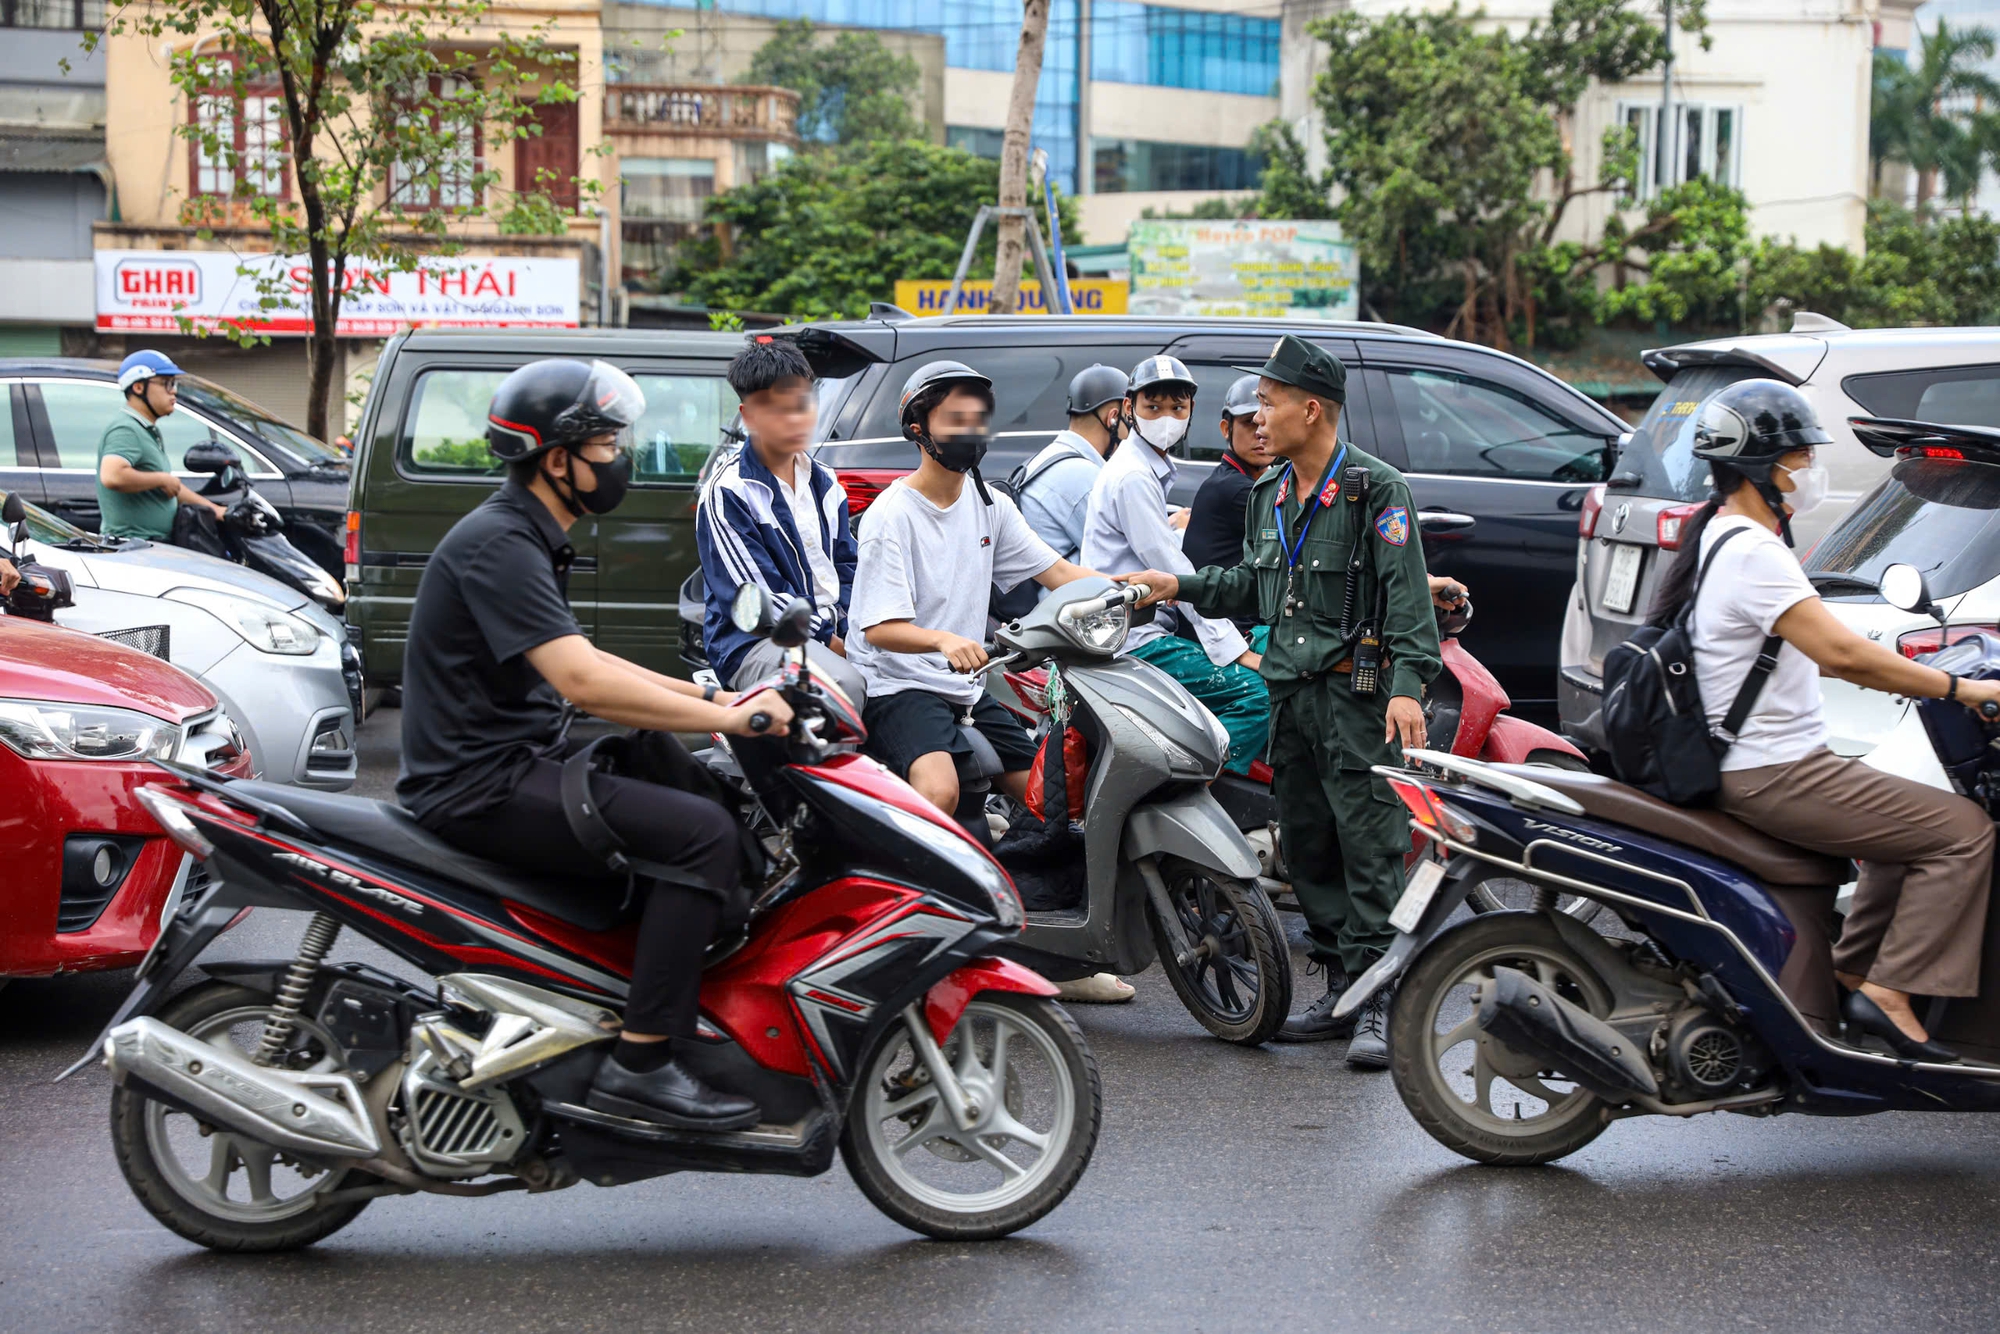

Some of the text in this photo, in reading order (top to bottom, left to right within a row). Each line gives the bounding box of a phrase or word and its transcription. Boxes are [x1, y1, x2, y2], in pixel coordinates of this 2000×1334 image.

[414, 262, 516, 297] THÁI
[1523, 817, 1623, 853] VISION
[272, 852, 425, 916] AIR BLADE
